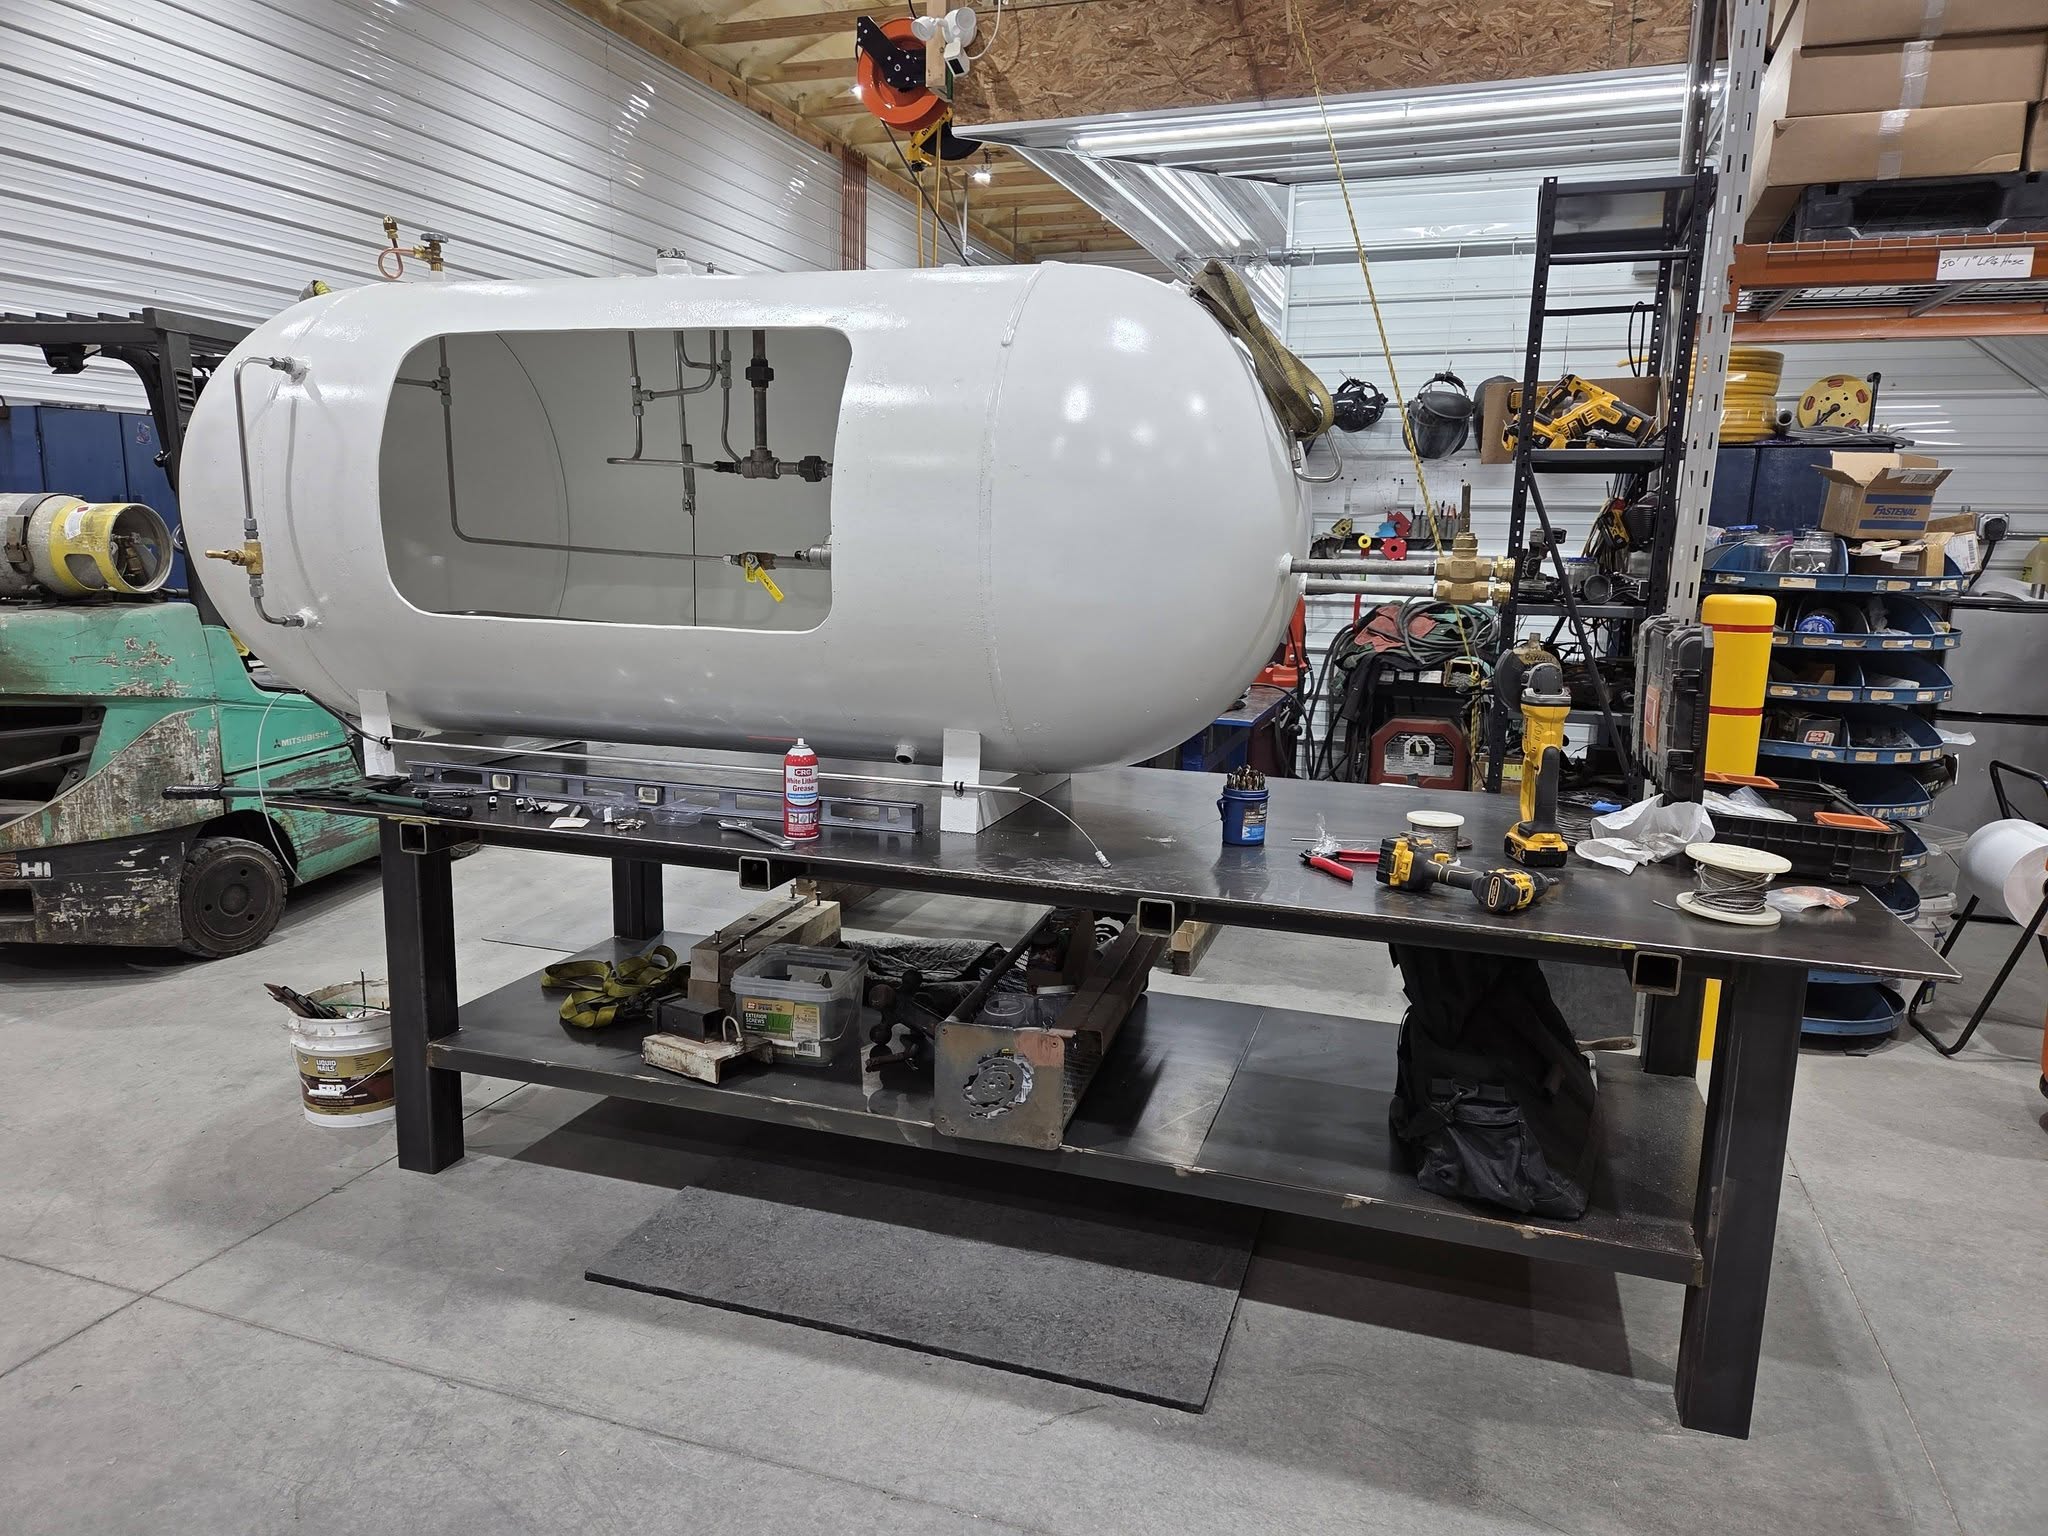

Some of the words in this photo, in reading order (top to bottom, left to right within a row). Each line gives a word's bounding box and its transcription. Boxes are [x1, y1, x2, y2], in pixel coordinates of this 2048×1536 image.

[2000, 253, 2025, 267] Hose
[281, 730, 329, 747] MITSUBISHI
[795, 768, 812, 776] CRC
[787, 777, 801, 785] White
[792, 784, 814, 792] Grease
[745, 1012, 767, 1020] EXTERIOR
